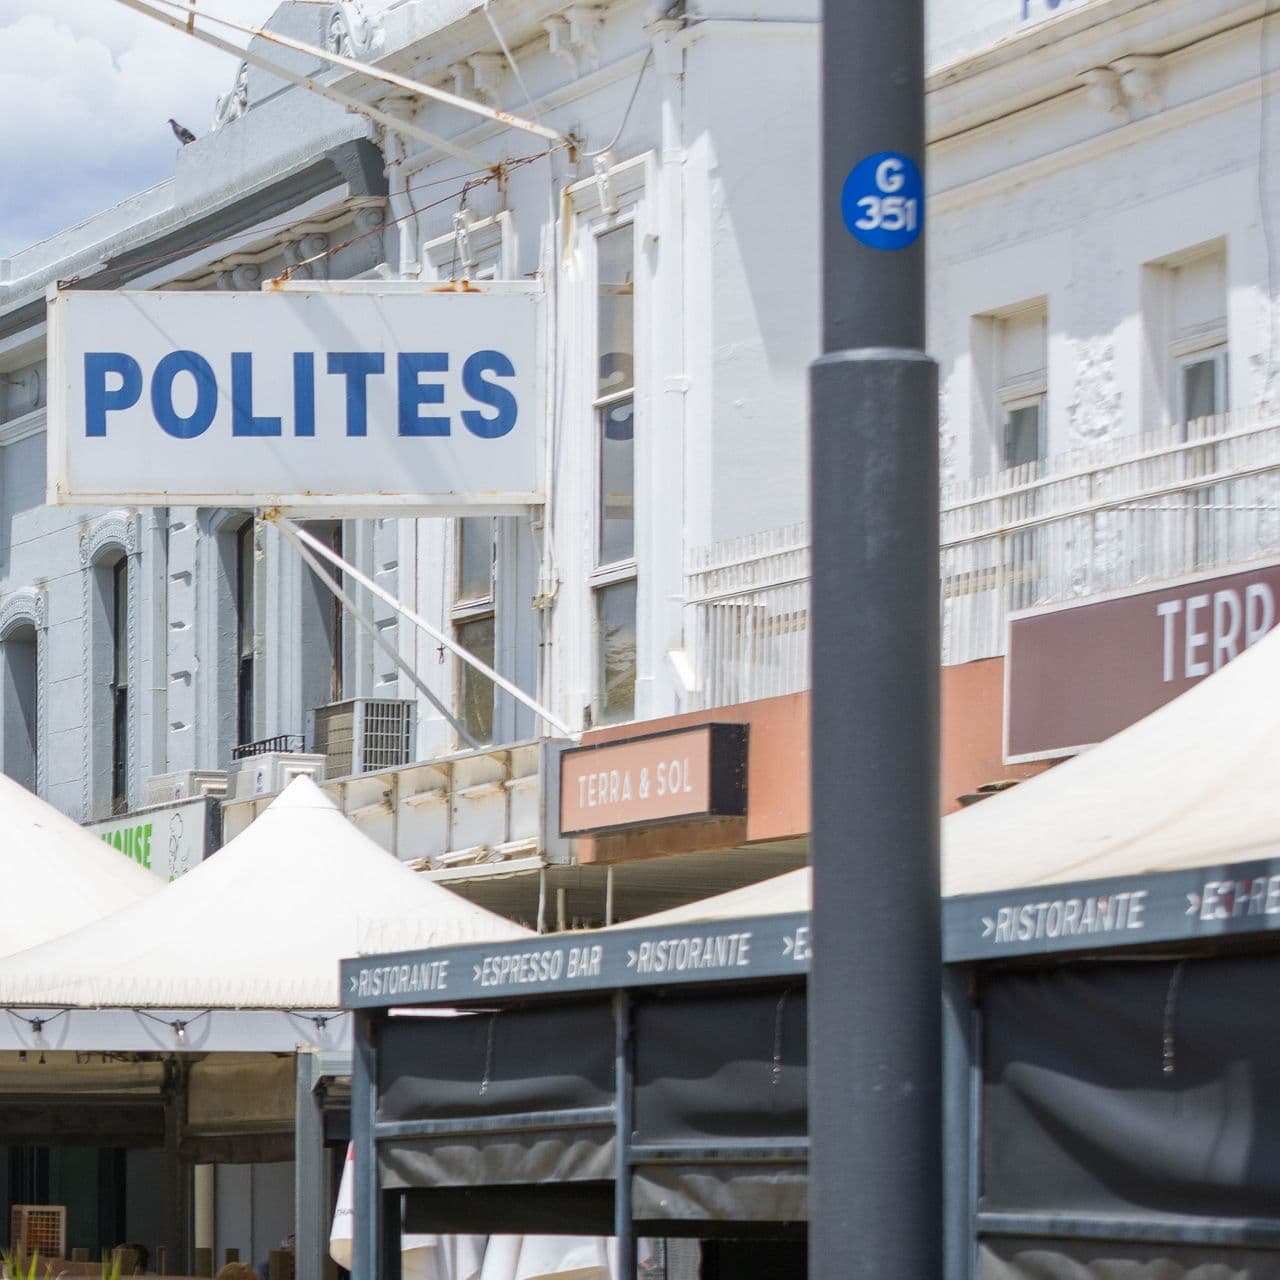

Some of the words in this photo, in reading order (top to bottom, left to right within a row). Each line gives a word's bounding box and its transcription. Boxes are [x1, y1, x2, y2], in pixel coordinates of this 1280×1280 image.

[875, 158, 905, 193] G
[854, 195, 917, 231] 351
[83, 349, 519, 440] POLITES
[578, 769, 633, 809] TERRA
[639, 767, 650, 799] &
[656, 758, 694, 797] SOL
[567, 945, 603, 979] BAR
